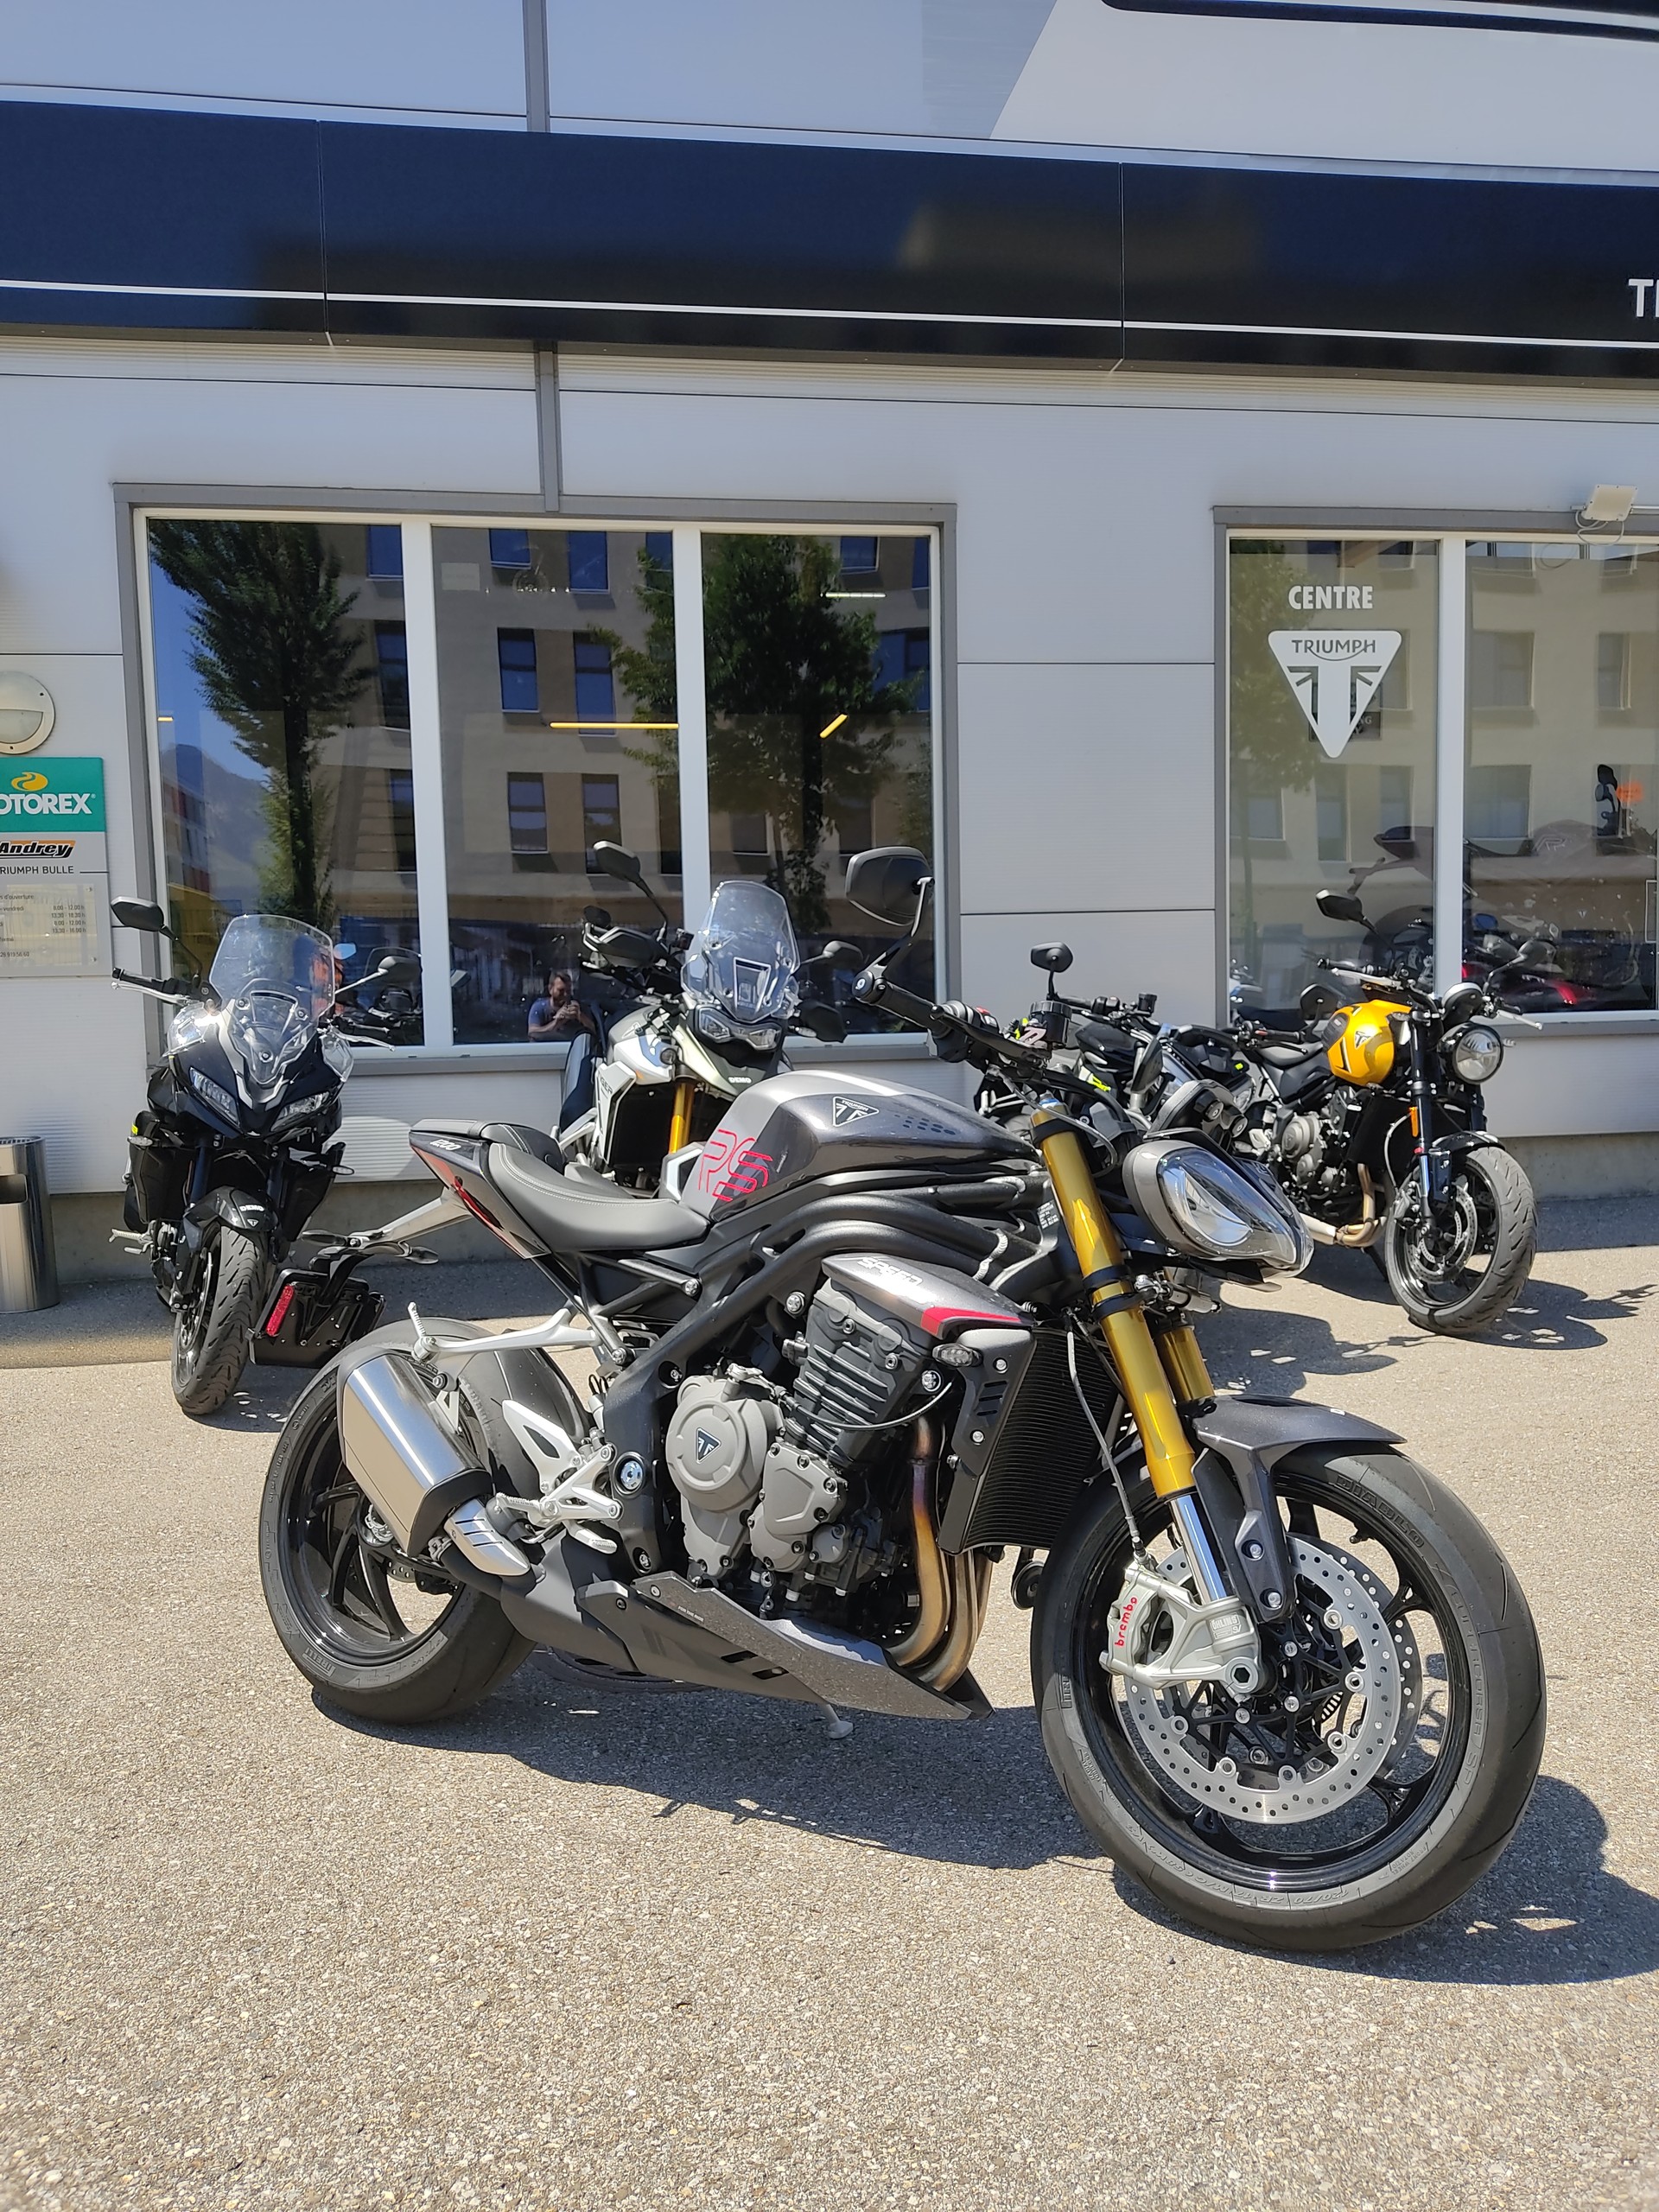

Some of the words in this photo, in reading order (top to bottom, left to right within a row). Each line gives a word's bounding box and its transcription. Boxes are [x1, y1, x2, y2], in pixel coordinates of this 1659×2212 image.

[1628, 278, 1659, 318] T
[1288, 585, 1373, 610] CENTRE
[1291, 639, 1376, 660] TRIUMPH
[0, 841, 71, 857] Andrey
[42, 865, 74, 874] BULLE
[728, 1076, 753, 1084] DEMO
[697, 1128, 774, 1202] RS
[238, 1204, 265, 1212] DEMO
[1336, 1473, 1425, 1548] DIABLO
[1114, 1596, 1138, 1647] brembo
[302, 1647, 336, 1677] PIRELLI
